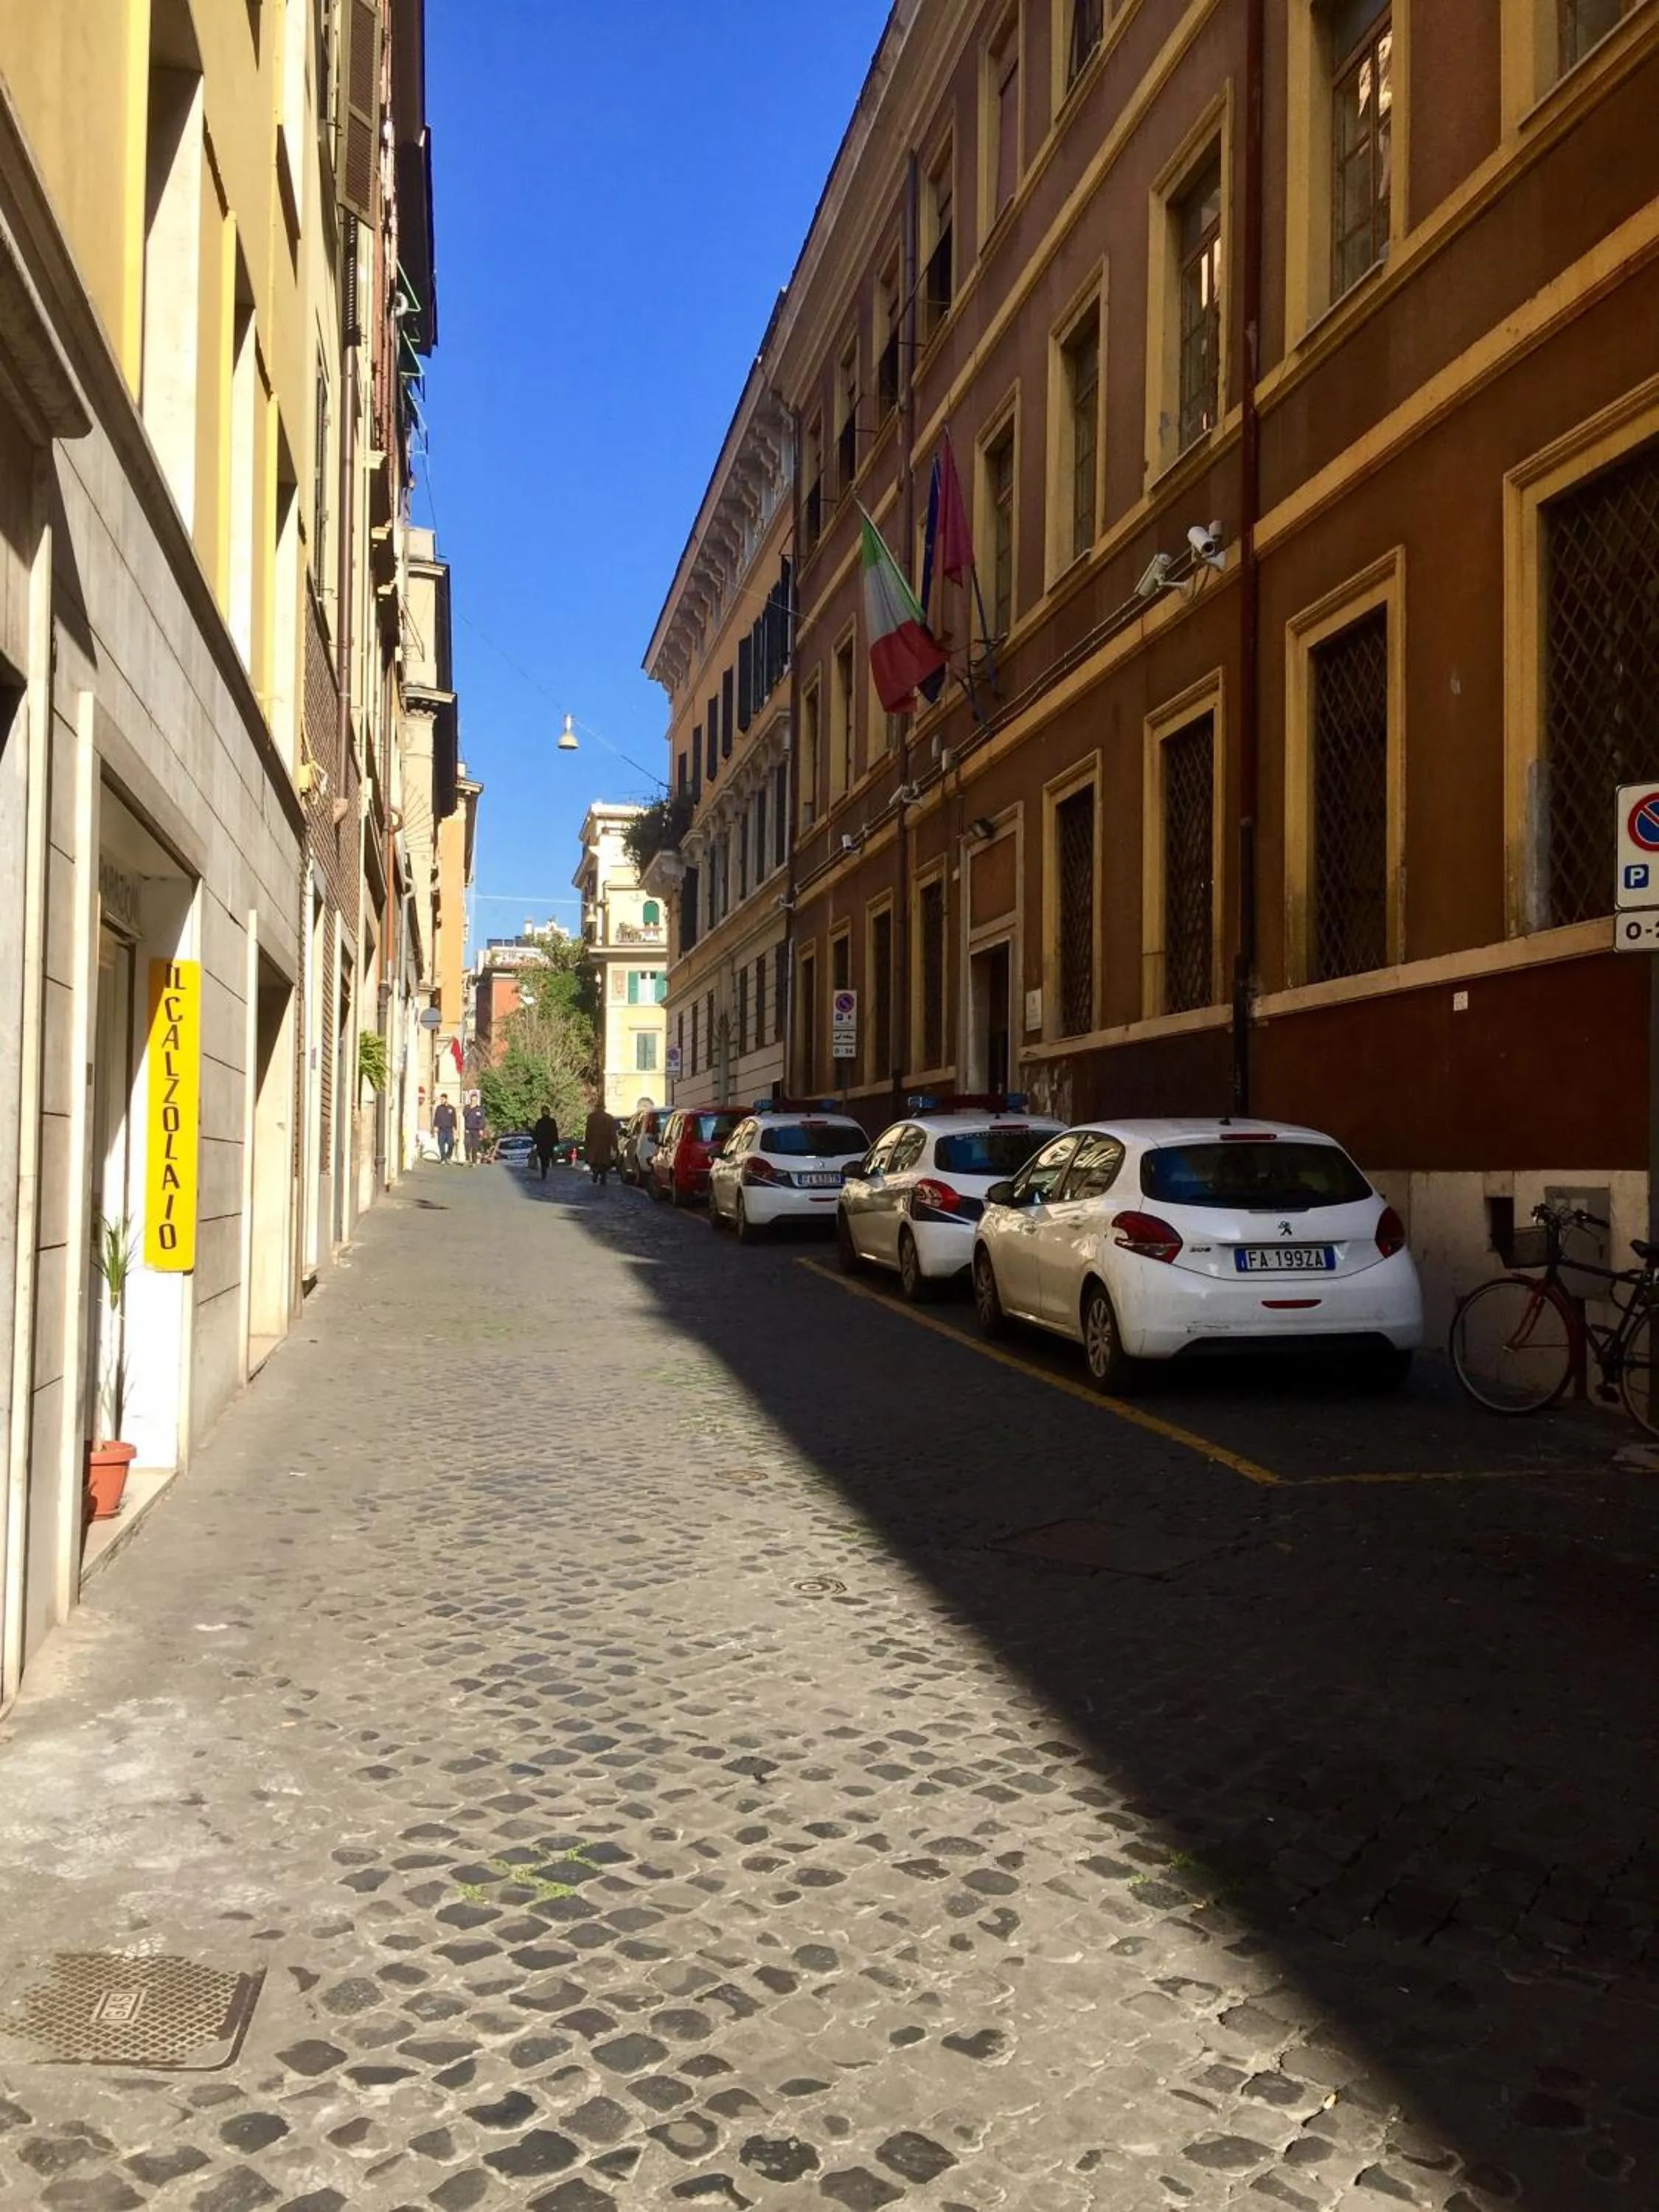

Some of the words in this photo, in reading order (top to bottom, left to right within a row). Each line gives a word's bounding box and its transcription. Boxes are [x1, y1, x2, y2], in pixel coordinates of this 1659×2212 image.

[1630, 868, 1645, 886] P
[164, 964, 187, 990] IL
[159, 996, 184, 1250] CALZOLAIO
[1248, 1252, 1268, 1267] FA
[1275, 1251, 1324, 1267] 199ZA
[105, 1994, 133, 2017] GAS
